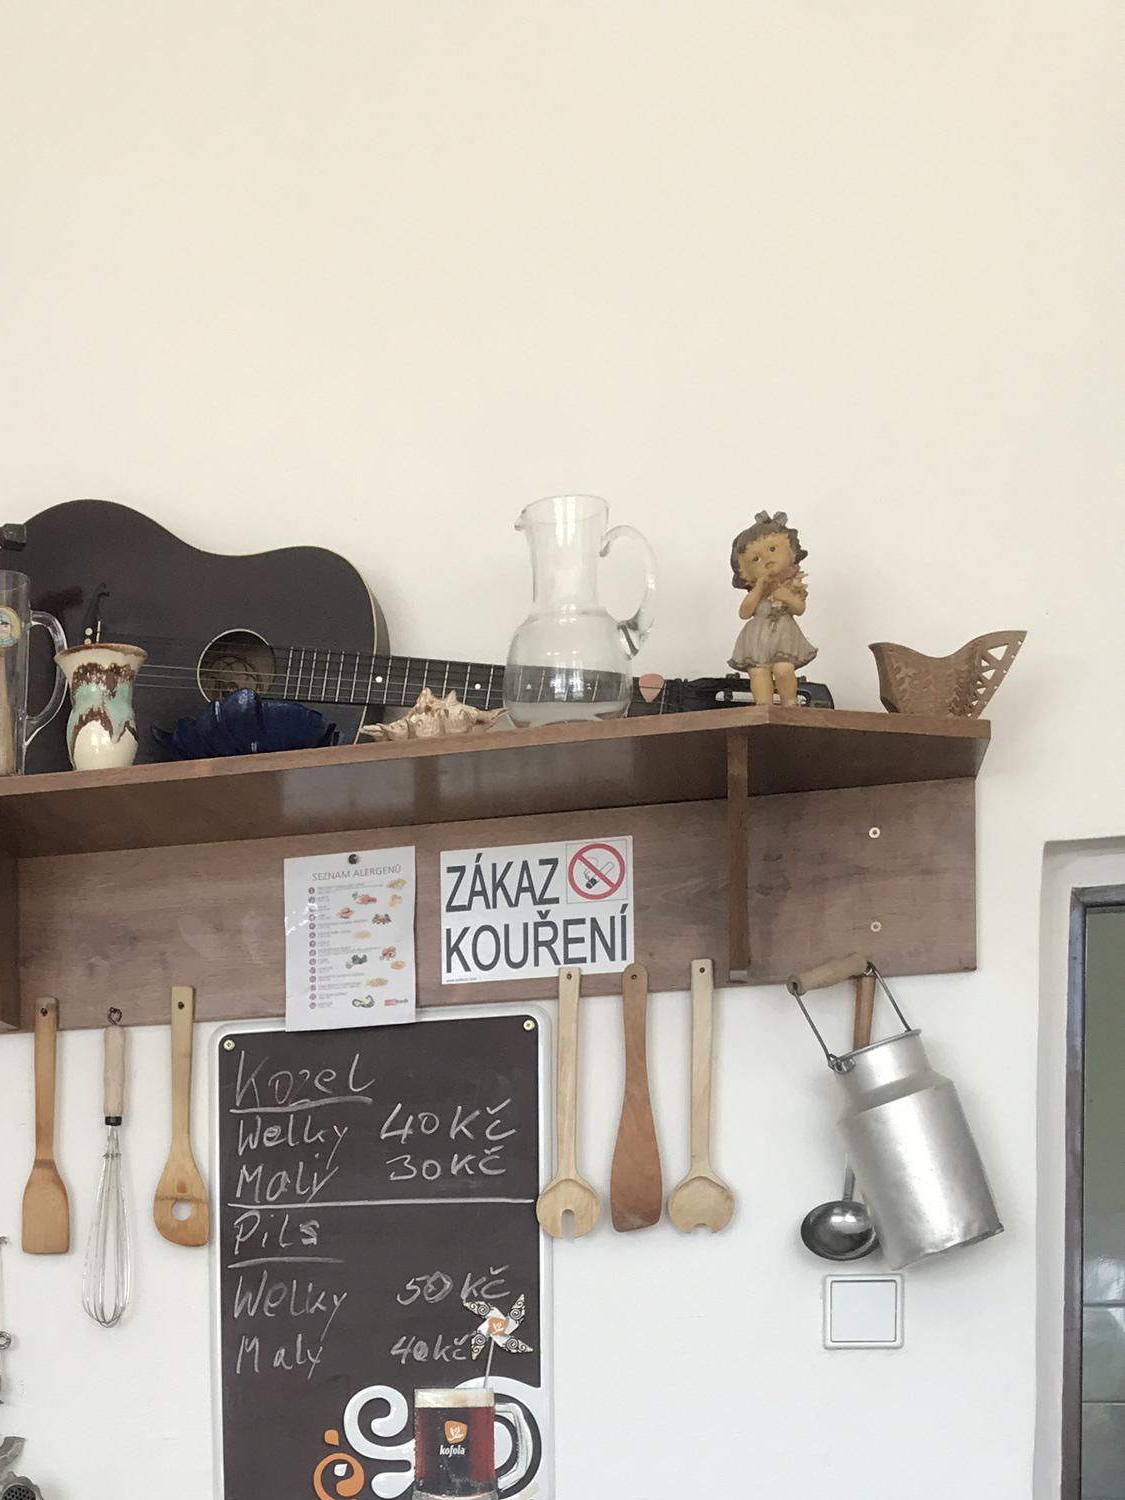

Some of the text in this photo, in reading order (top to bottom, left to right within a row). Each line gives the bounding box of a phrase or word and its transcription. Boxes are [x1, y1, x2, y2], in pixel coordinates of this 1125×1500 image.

[312, 864, 402, 882] SEZNAM ALERGENŮ
[445, 853, 561, 913] ZÁKAZ
[446, 903, 630, 974] KOUŘENÍ
[235, 1050, 375, 1108] Kozel
[439, 1444, 466, 1458] kofola
